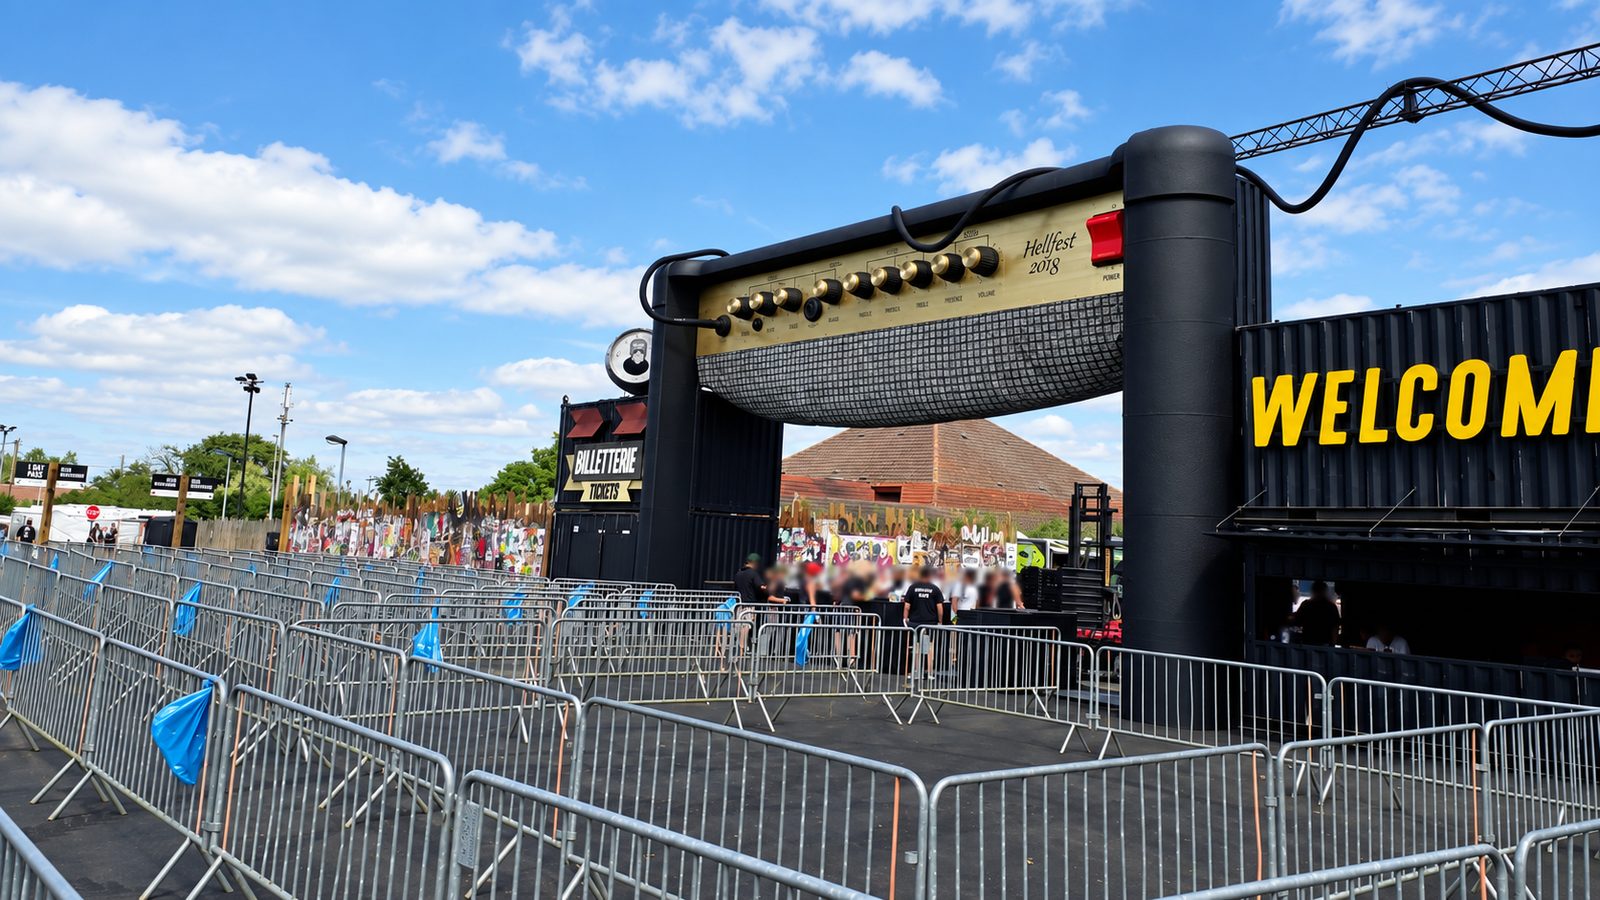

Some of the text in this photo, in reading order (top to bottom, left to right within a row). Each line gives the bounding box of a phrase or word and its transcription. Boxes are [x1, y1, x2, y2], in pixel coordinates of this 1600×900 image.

[1023, 231, 1077, 259] Hellfest
[1028, 258, 1061, 276] 2018
[1102, 272, 1121, 282] POWER
[574, 446, 639, 475] BILLETTERIE
[589, 482, 620, 500] TICKETS
